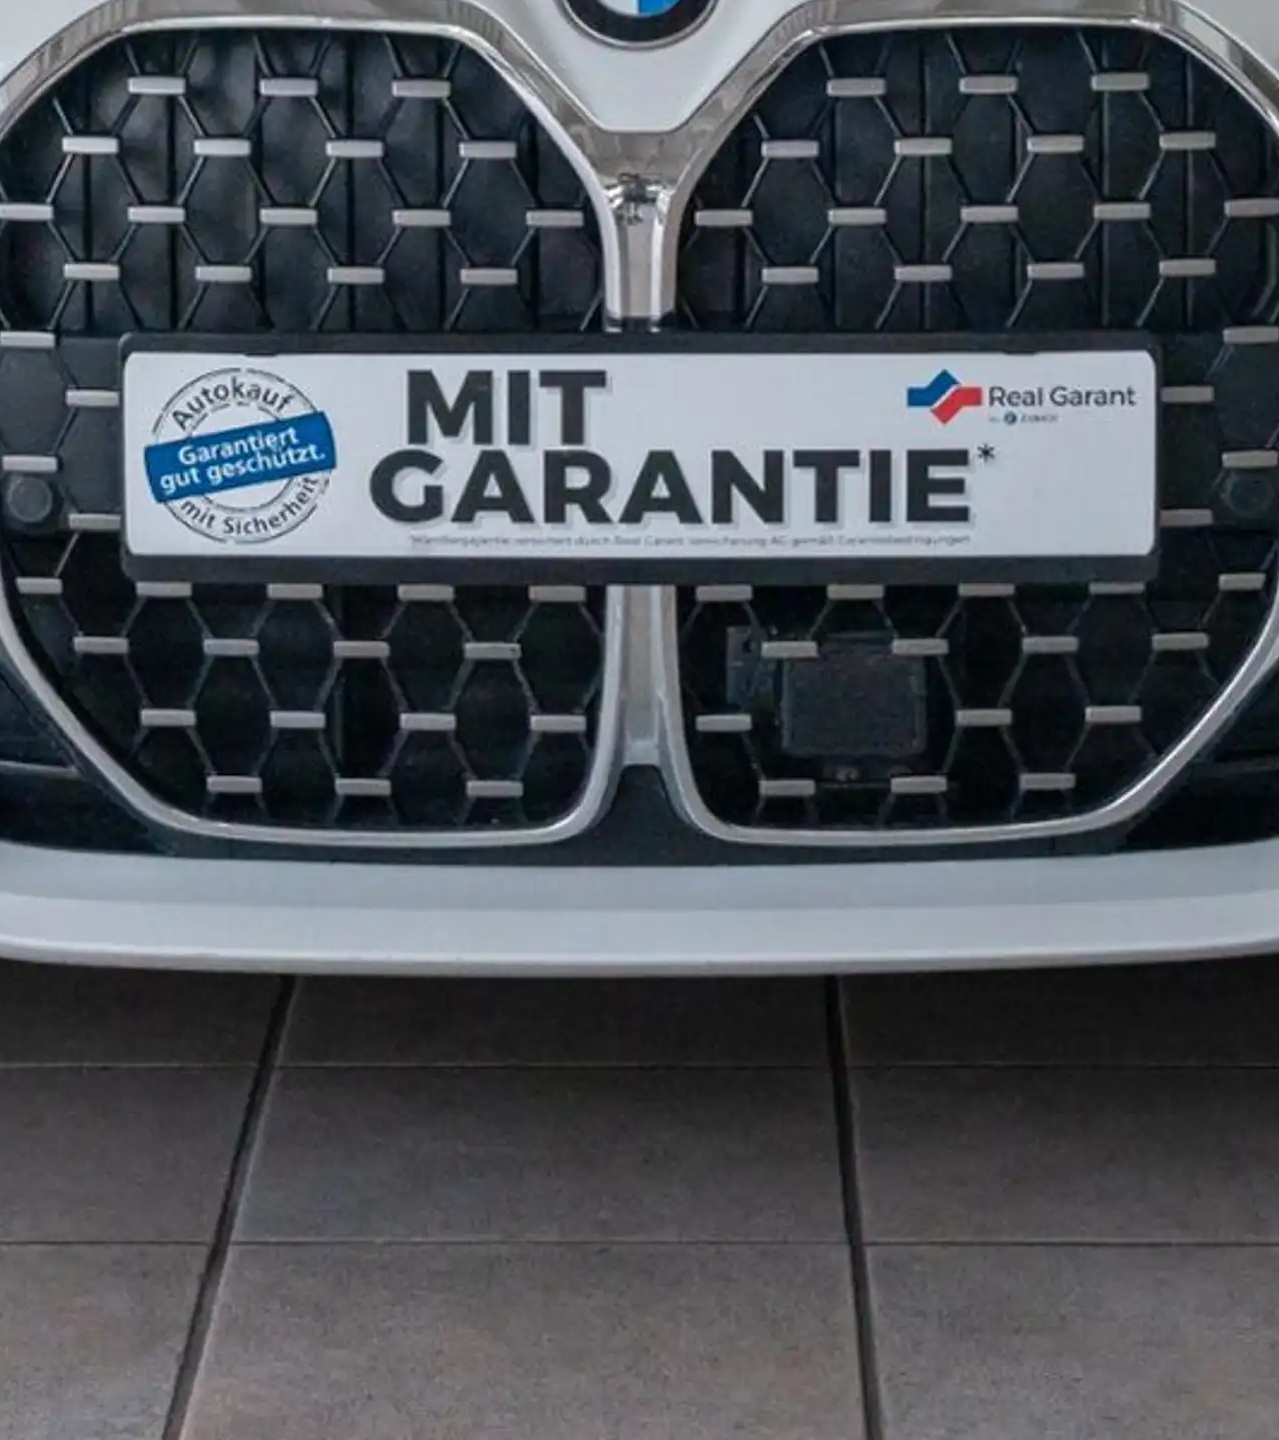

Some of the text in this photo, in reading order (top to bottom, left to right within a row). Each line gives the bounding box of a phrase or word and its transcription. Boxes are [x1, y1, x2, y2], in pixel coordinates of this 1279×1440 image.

[172, 376, 294, 431] Autokauf
[407, 369, 608, 446] MIT
[988, 385, 1137, 407] Real Garant
[178, 427, 299, 465] Garantiert
[160, 466, 200, 495] gut
[180, 476, 319, 535] mit Sicherheit
